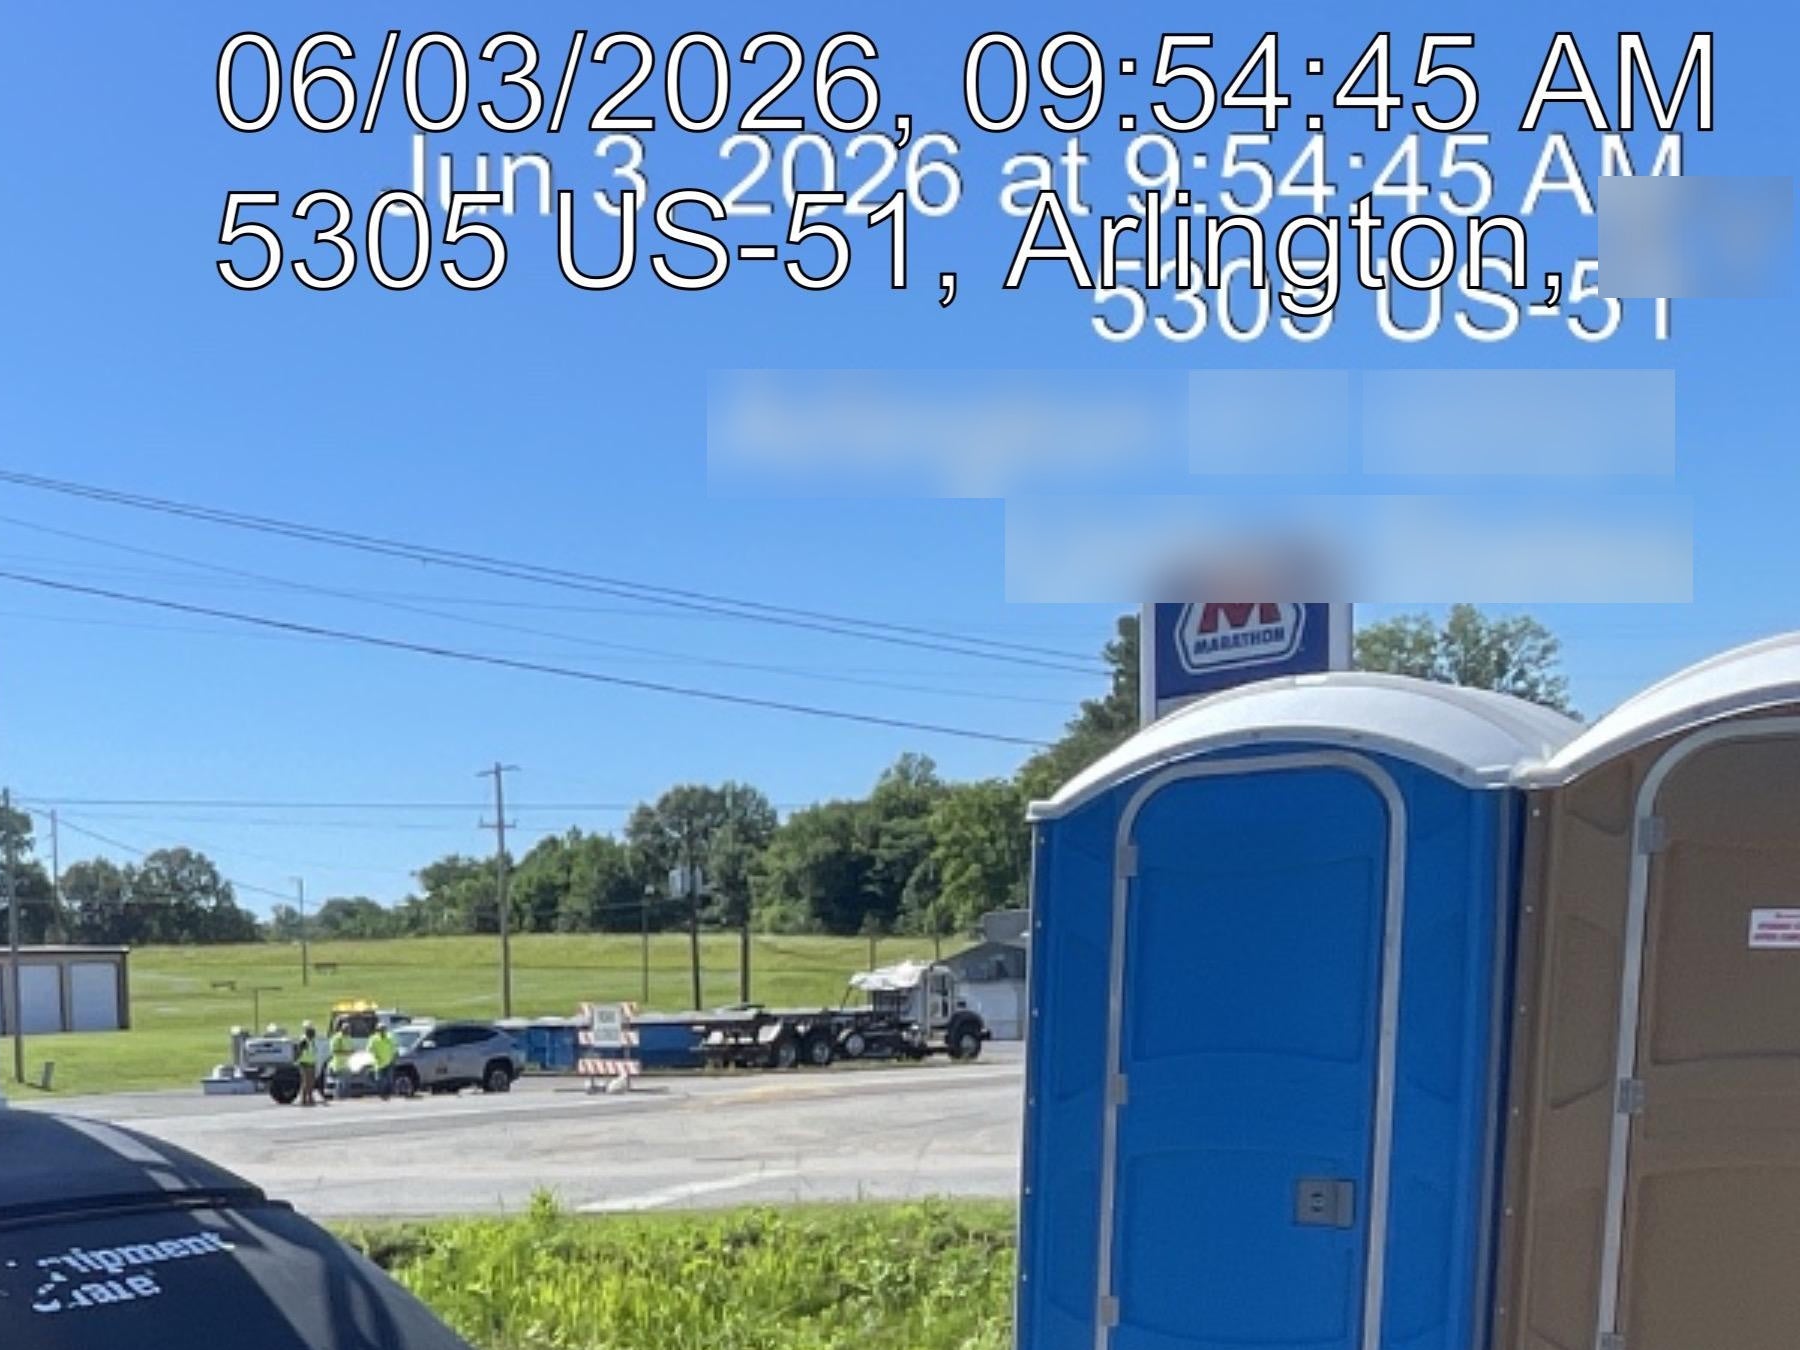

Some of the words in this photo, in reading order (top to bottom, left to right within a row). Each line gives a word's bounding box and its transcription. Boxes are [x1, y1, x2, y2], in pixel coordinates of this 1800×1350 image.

[1194, 627, 1285, 655] MARATHON
[6, 1231, 236, 1276] ipment
[32, 1274, 162, 1313] are
